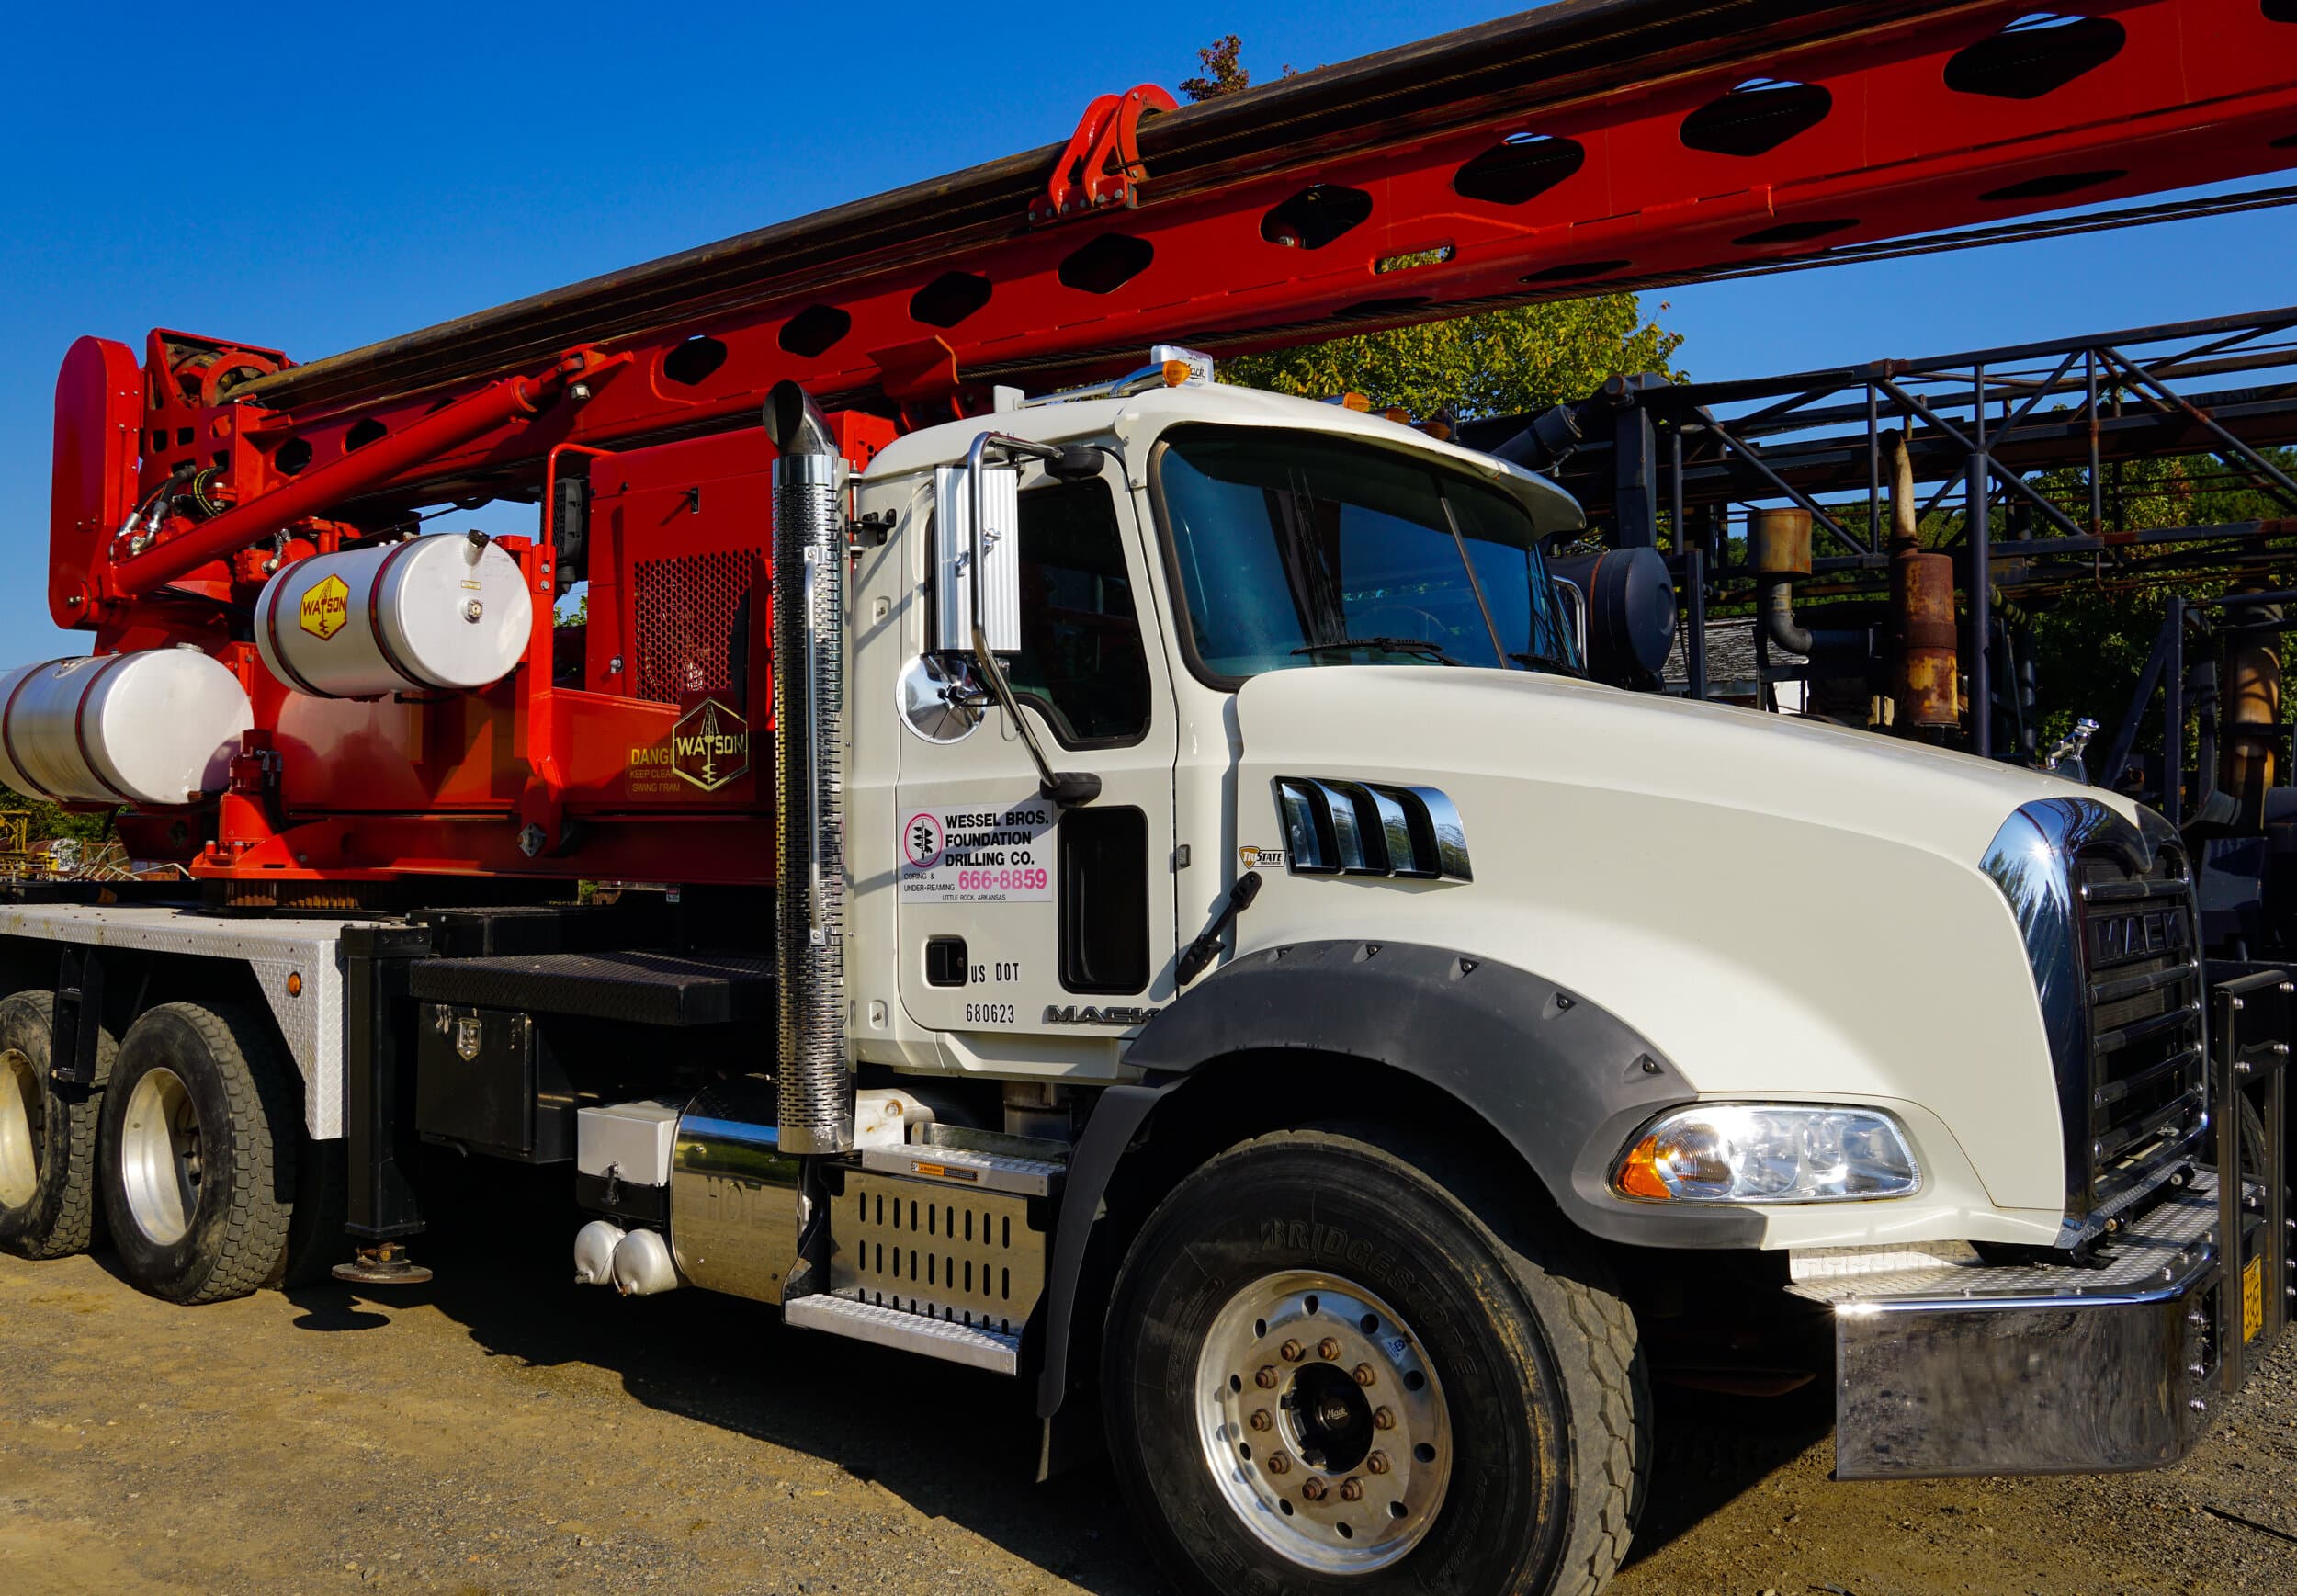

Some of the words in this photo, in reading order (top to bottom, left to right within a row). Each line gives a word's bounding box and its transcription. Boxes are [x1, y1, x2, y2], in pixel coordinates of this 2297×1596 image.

[302, 595, 346, 616] WATSON
[675, 734, 744, 756] WATSON
[630, 768, 650, 779] KEEP
[632, 783, 657, 793] SWING
[945, 813, 1001, 828] WESSEL
[1006, 810, 1049, 825] BROS.
[945, 831, 1032, 847] FOUNDATION
[945, 852, 1005, 866] DRILLING
[1011, 851, 1035, 865] CO.
[958, 868, 1047, 889] 666-8859
[2095, 911, 2189, 963] MACK
[970, 965, 985, 983] US
[995, 963, 1019, 981] DOT
[966, 1003, 1014, 1023] 680623
[1259, 1219, 1478, 1375] BRIDGESTONE
[1326, 1407, 1348, 1420] Mack
